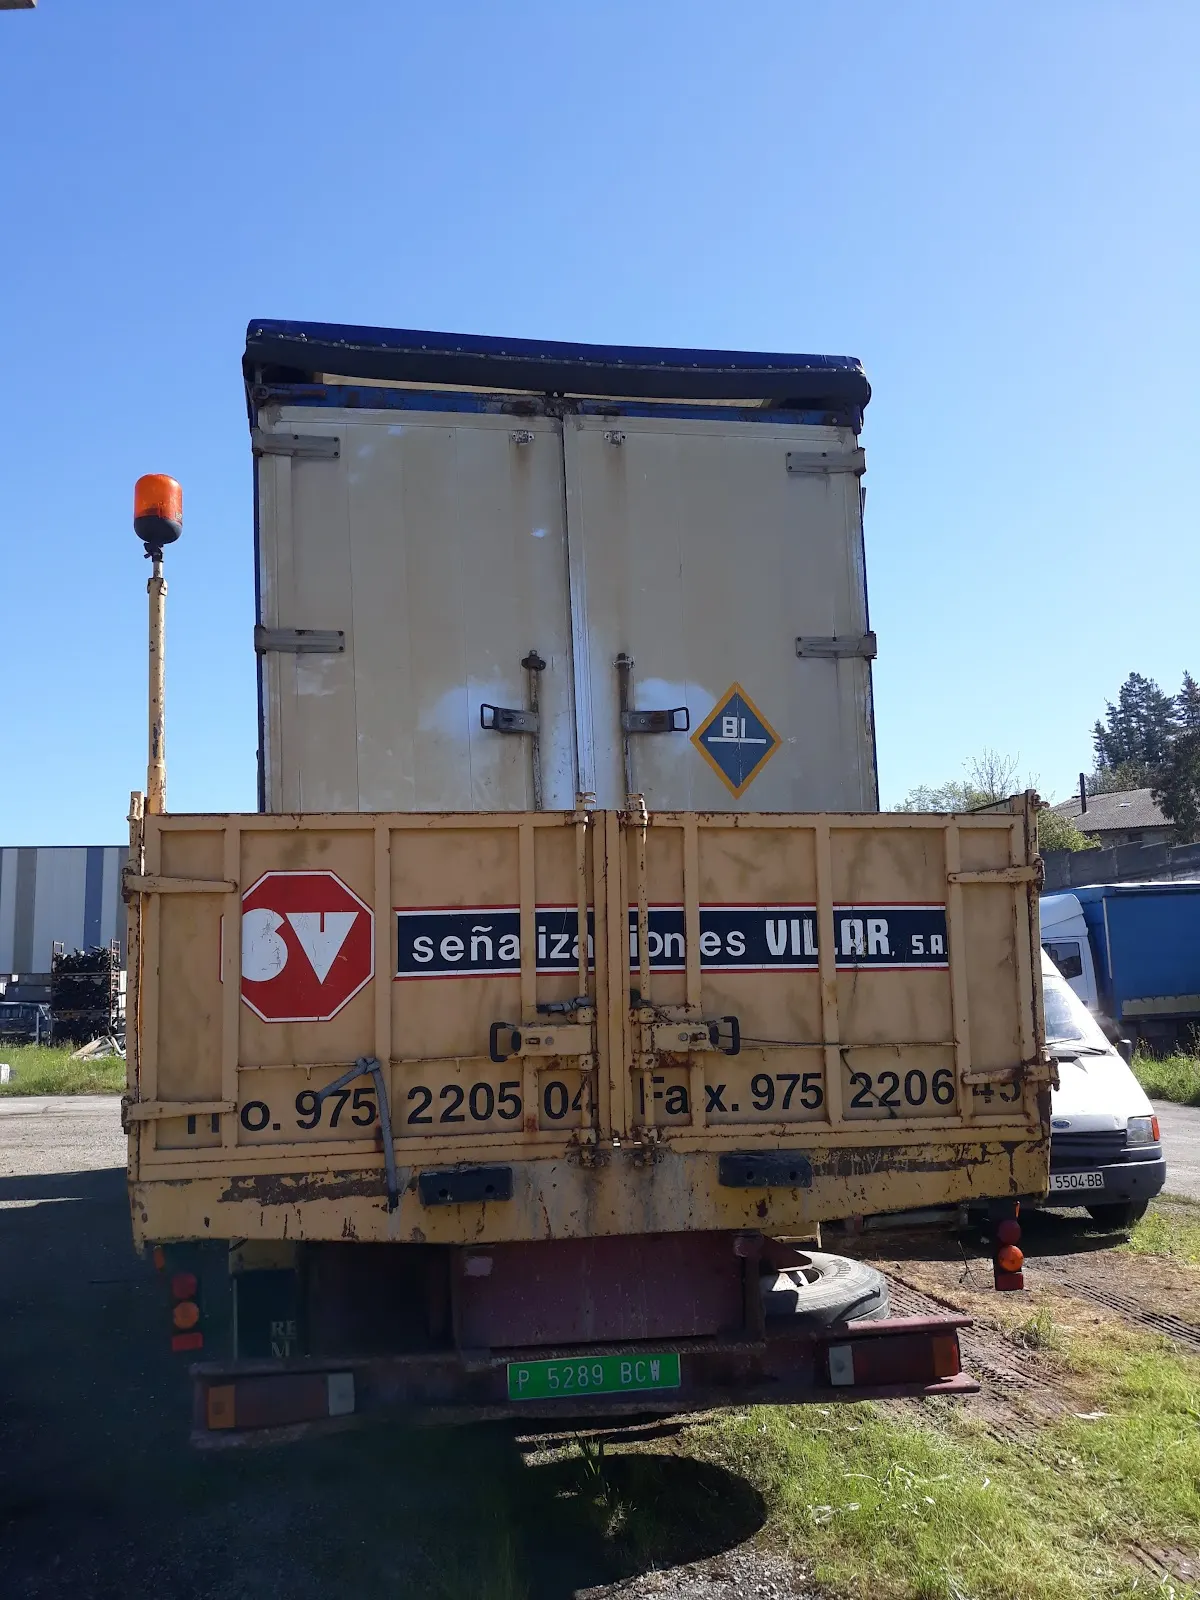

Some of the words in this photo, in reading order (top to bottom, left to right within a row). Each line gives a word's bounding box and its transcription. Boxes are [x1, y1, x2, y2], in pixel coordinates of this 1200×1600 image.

[295, 1087, 378, 1130] 975
[751, 1072, 824, 1111] 975
[547, 1364, 604, 1390] 5289
